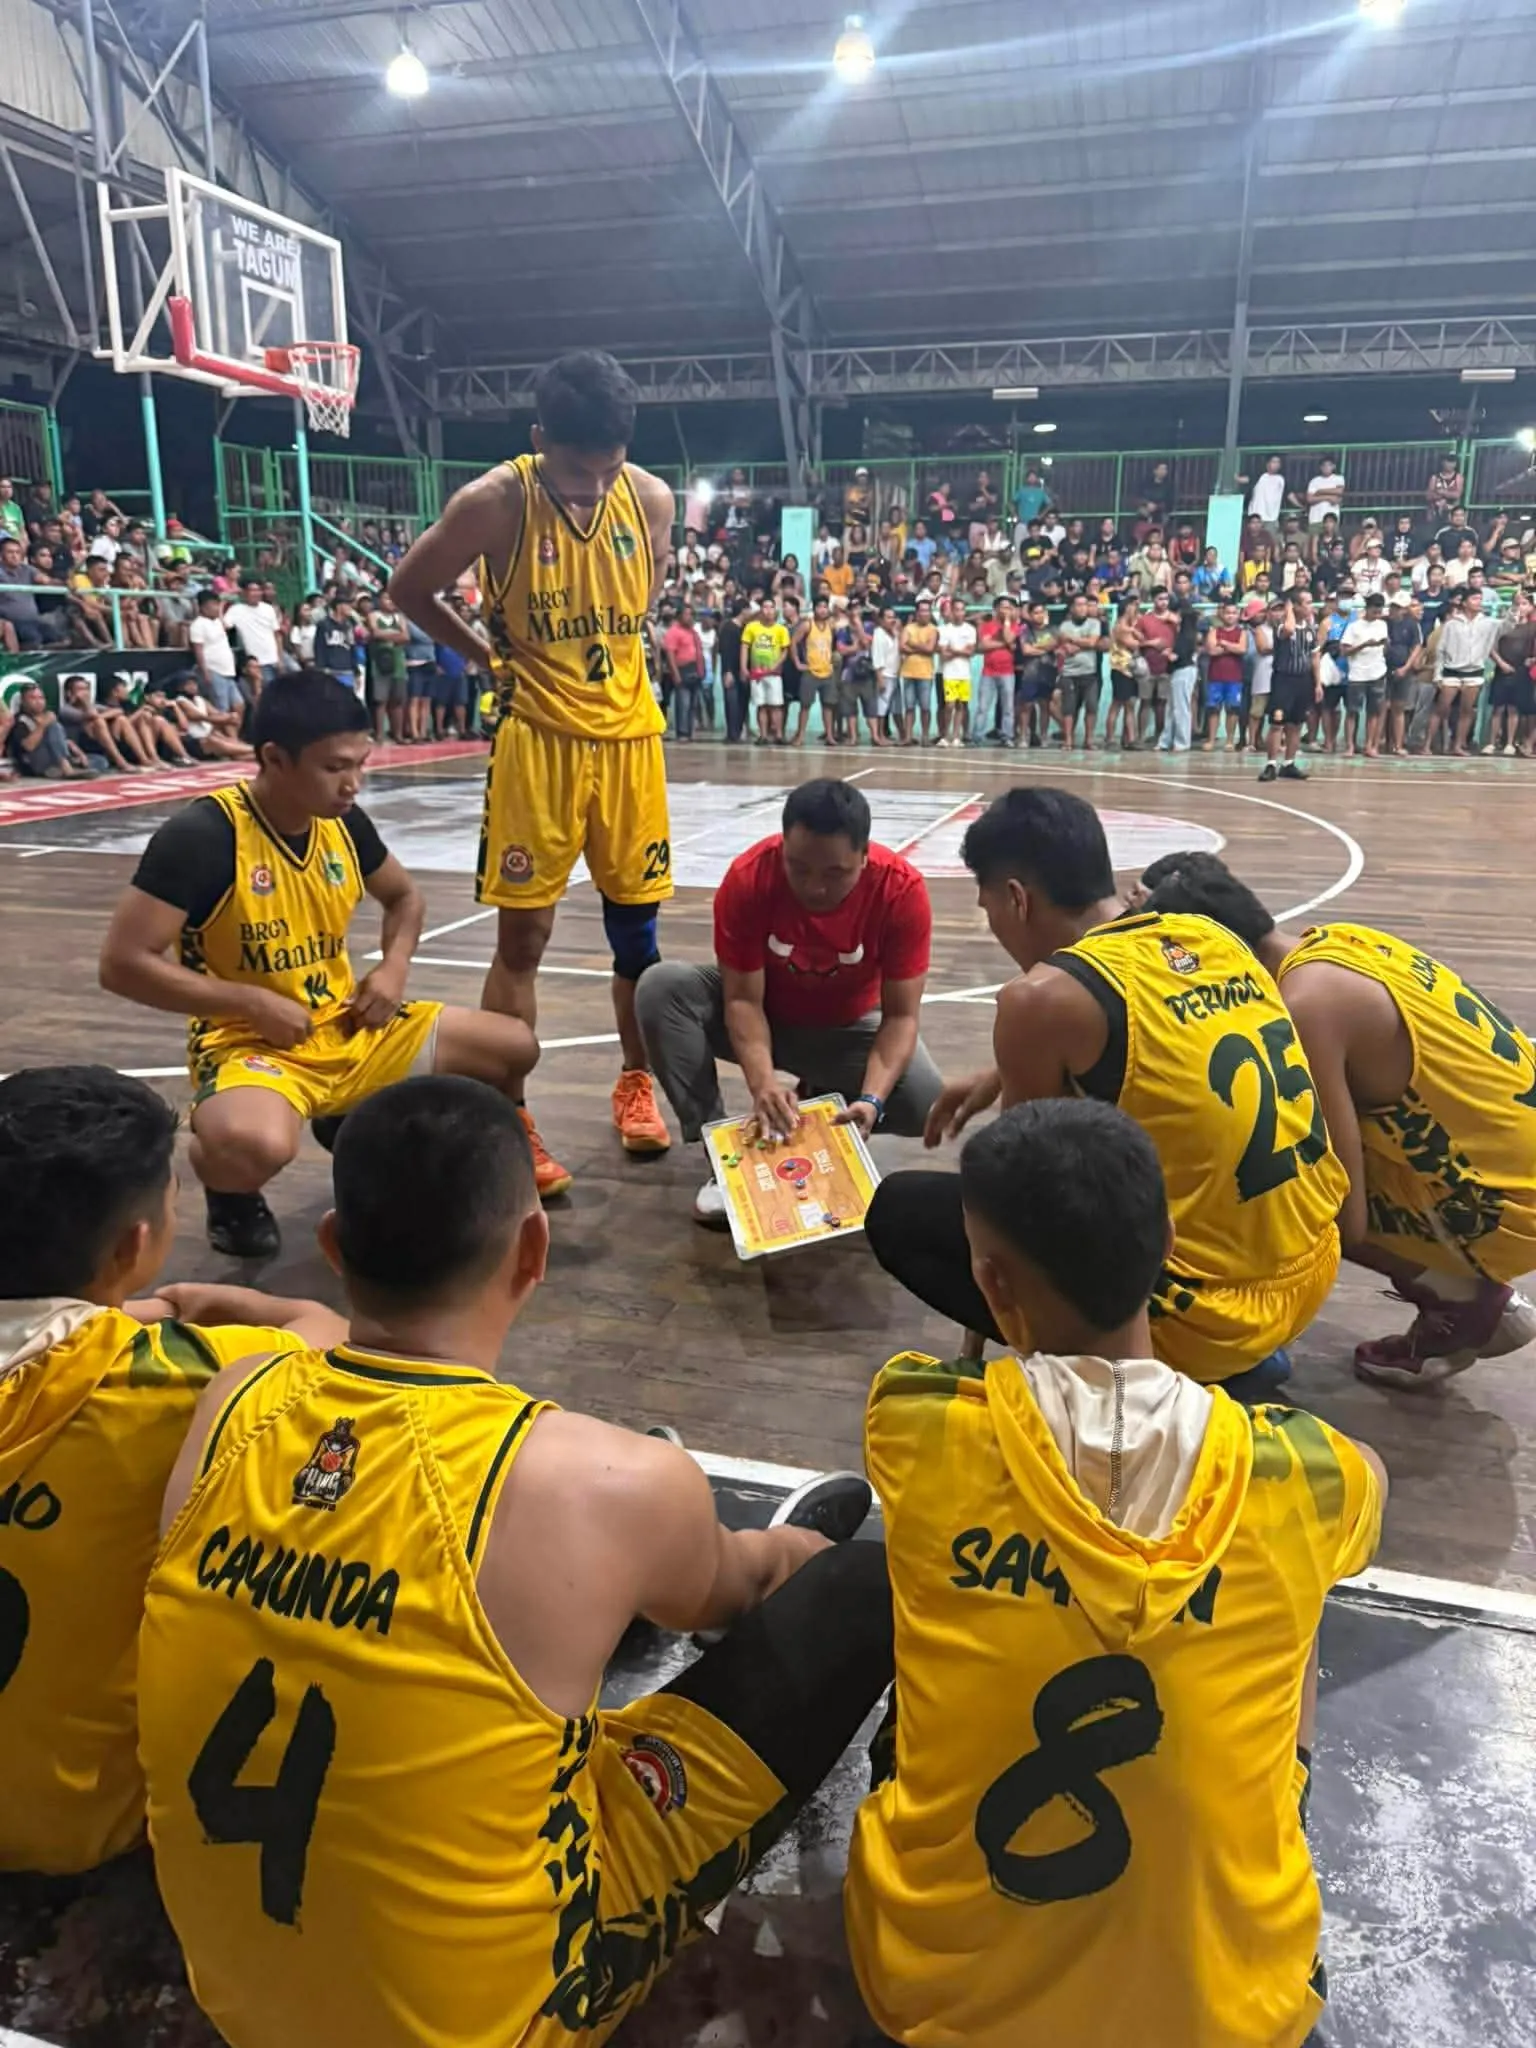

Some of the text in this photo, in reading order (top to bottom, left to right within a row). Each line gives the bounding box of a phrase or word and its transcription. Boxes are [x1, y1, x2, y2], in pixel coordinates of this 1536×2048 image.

[231, 214, 300, 258] WE ARE
[233, 237, 299, 289] TAGUM
[643, 838, 670, 882] 29
[239, 918, 290, 942] BRGY
[1208, 1017, 1328, 1204] 25
[197, 1526, 400, 1635] CAYUNDA
[949, 1527, 1223, 1625] SAYN
[187, 1656, 336, 1934] 4
[975, 1654, 1165, 1905] 8
